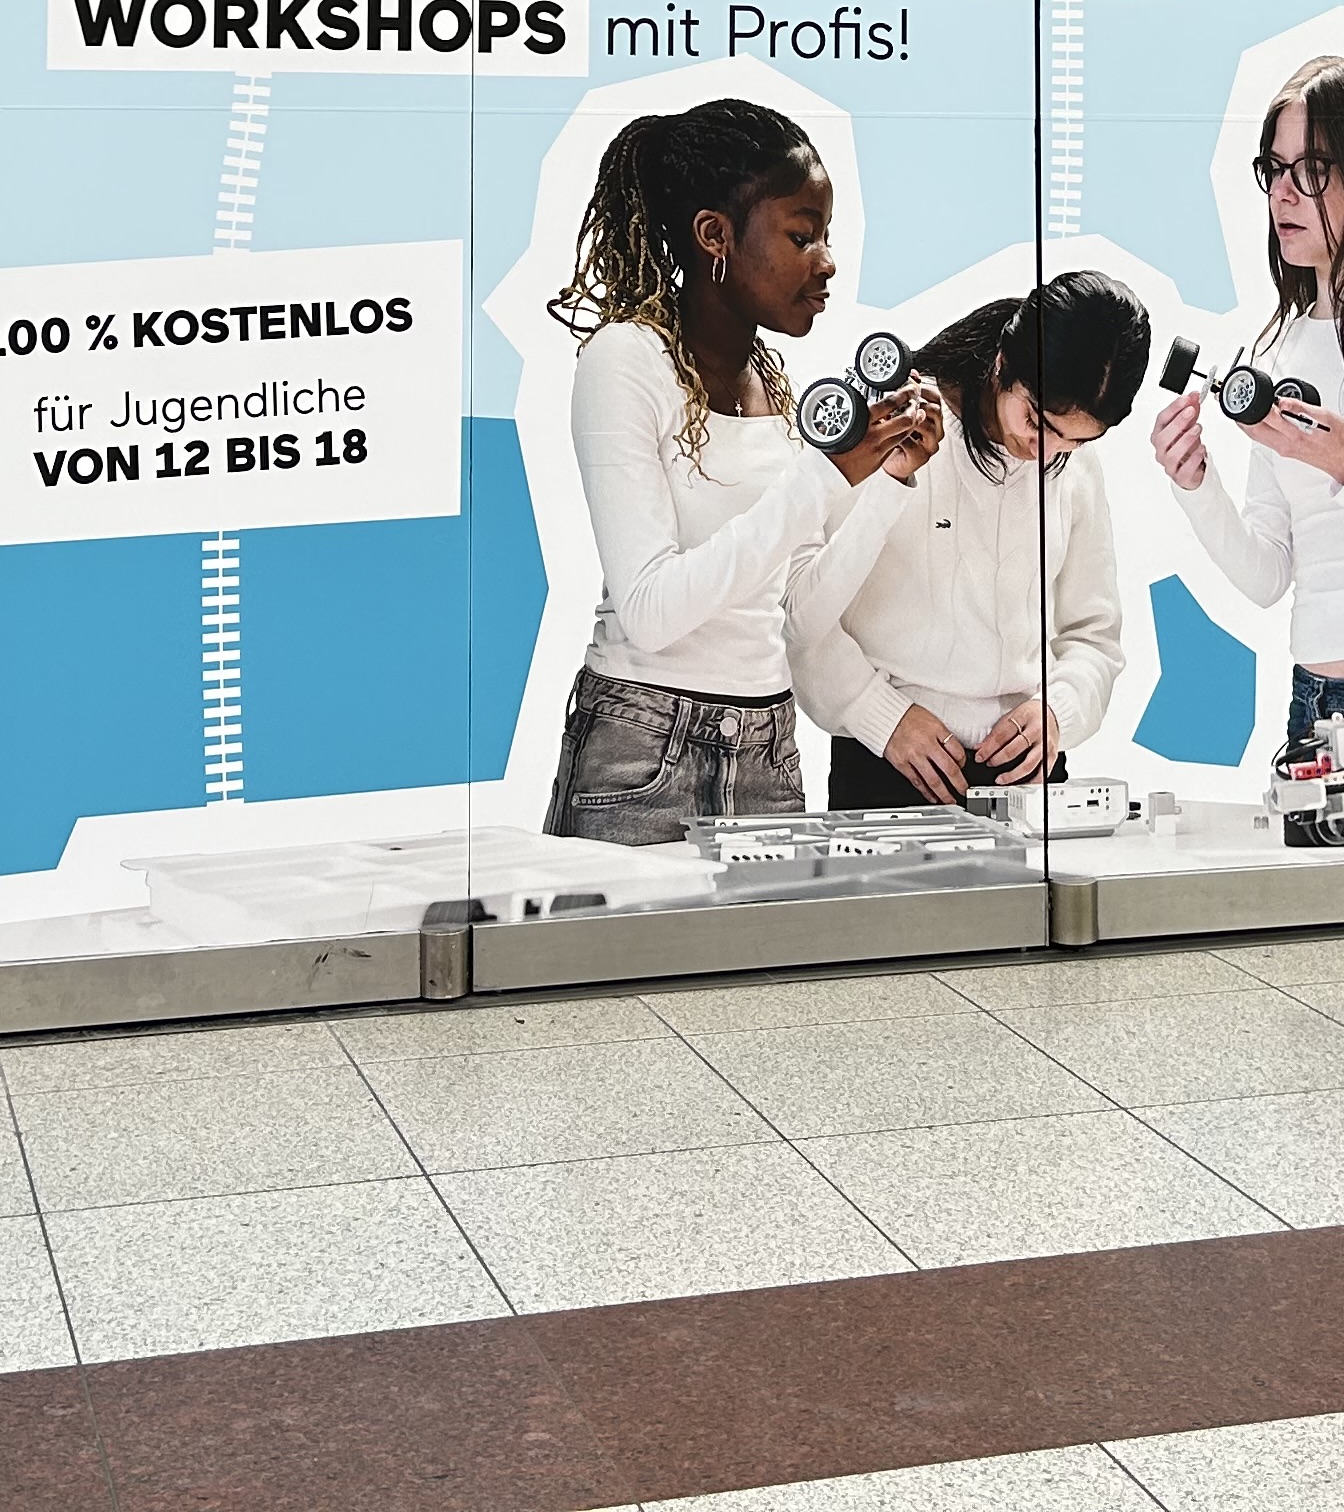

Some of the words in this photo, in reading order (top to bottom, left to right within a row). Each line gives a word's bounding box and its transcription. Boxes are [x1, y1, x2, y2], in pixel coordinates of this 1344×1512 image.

[607, 2, 700, 57] mit
[729, 4, 909, 61] Profis!
[85, 314, 119, 351] %
[132, 297, 413, 348] KOSTENLOS
[33, 394, 93, 433] für
[109, 378, 366, 433] Jugendliche
[32, 444, 140, 487] VON
[155, 439, 210, 479] 12
[226, 433, 301, 473] BIS
[315, 428, 368, 467] 18
